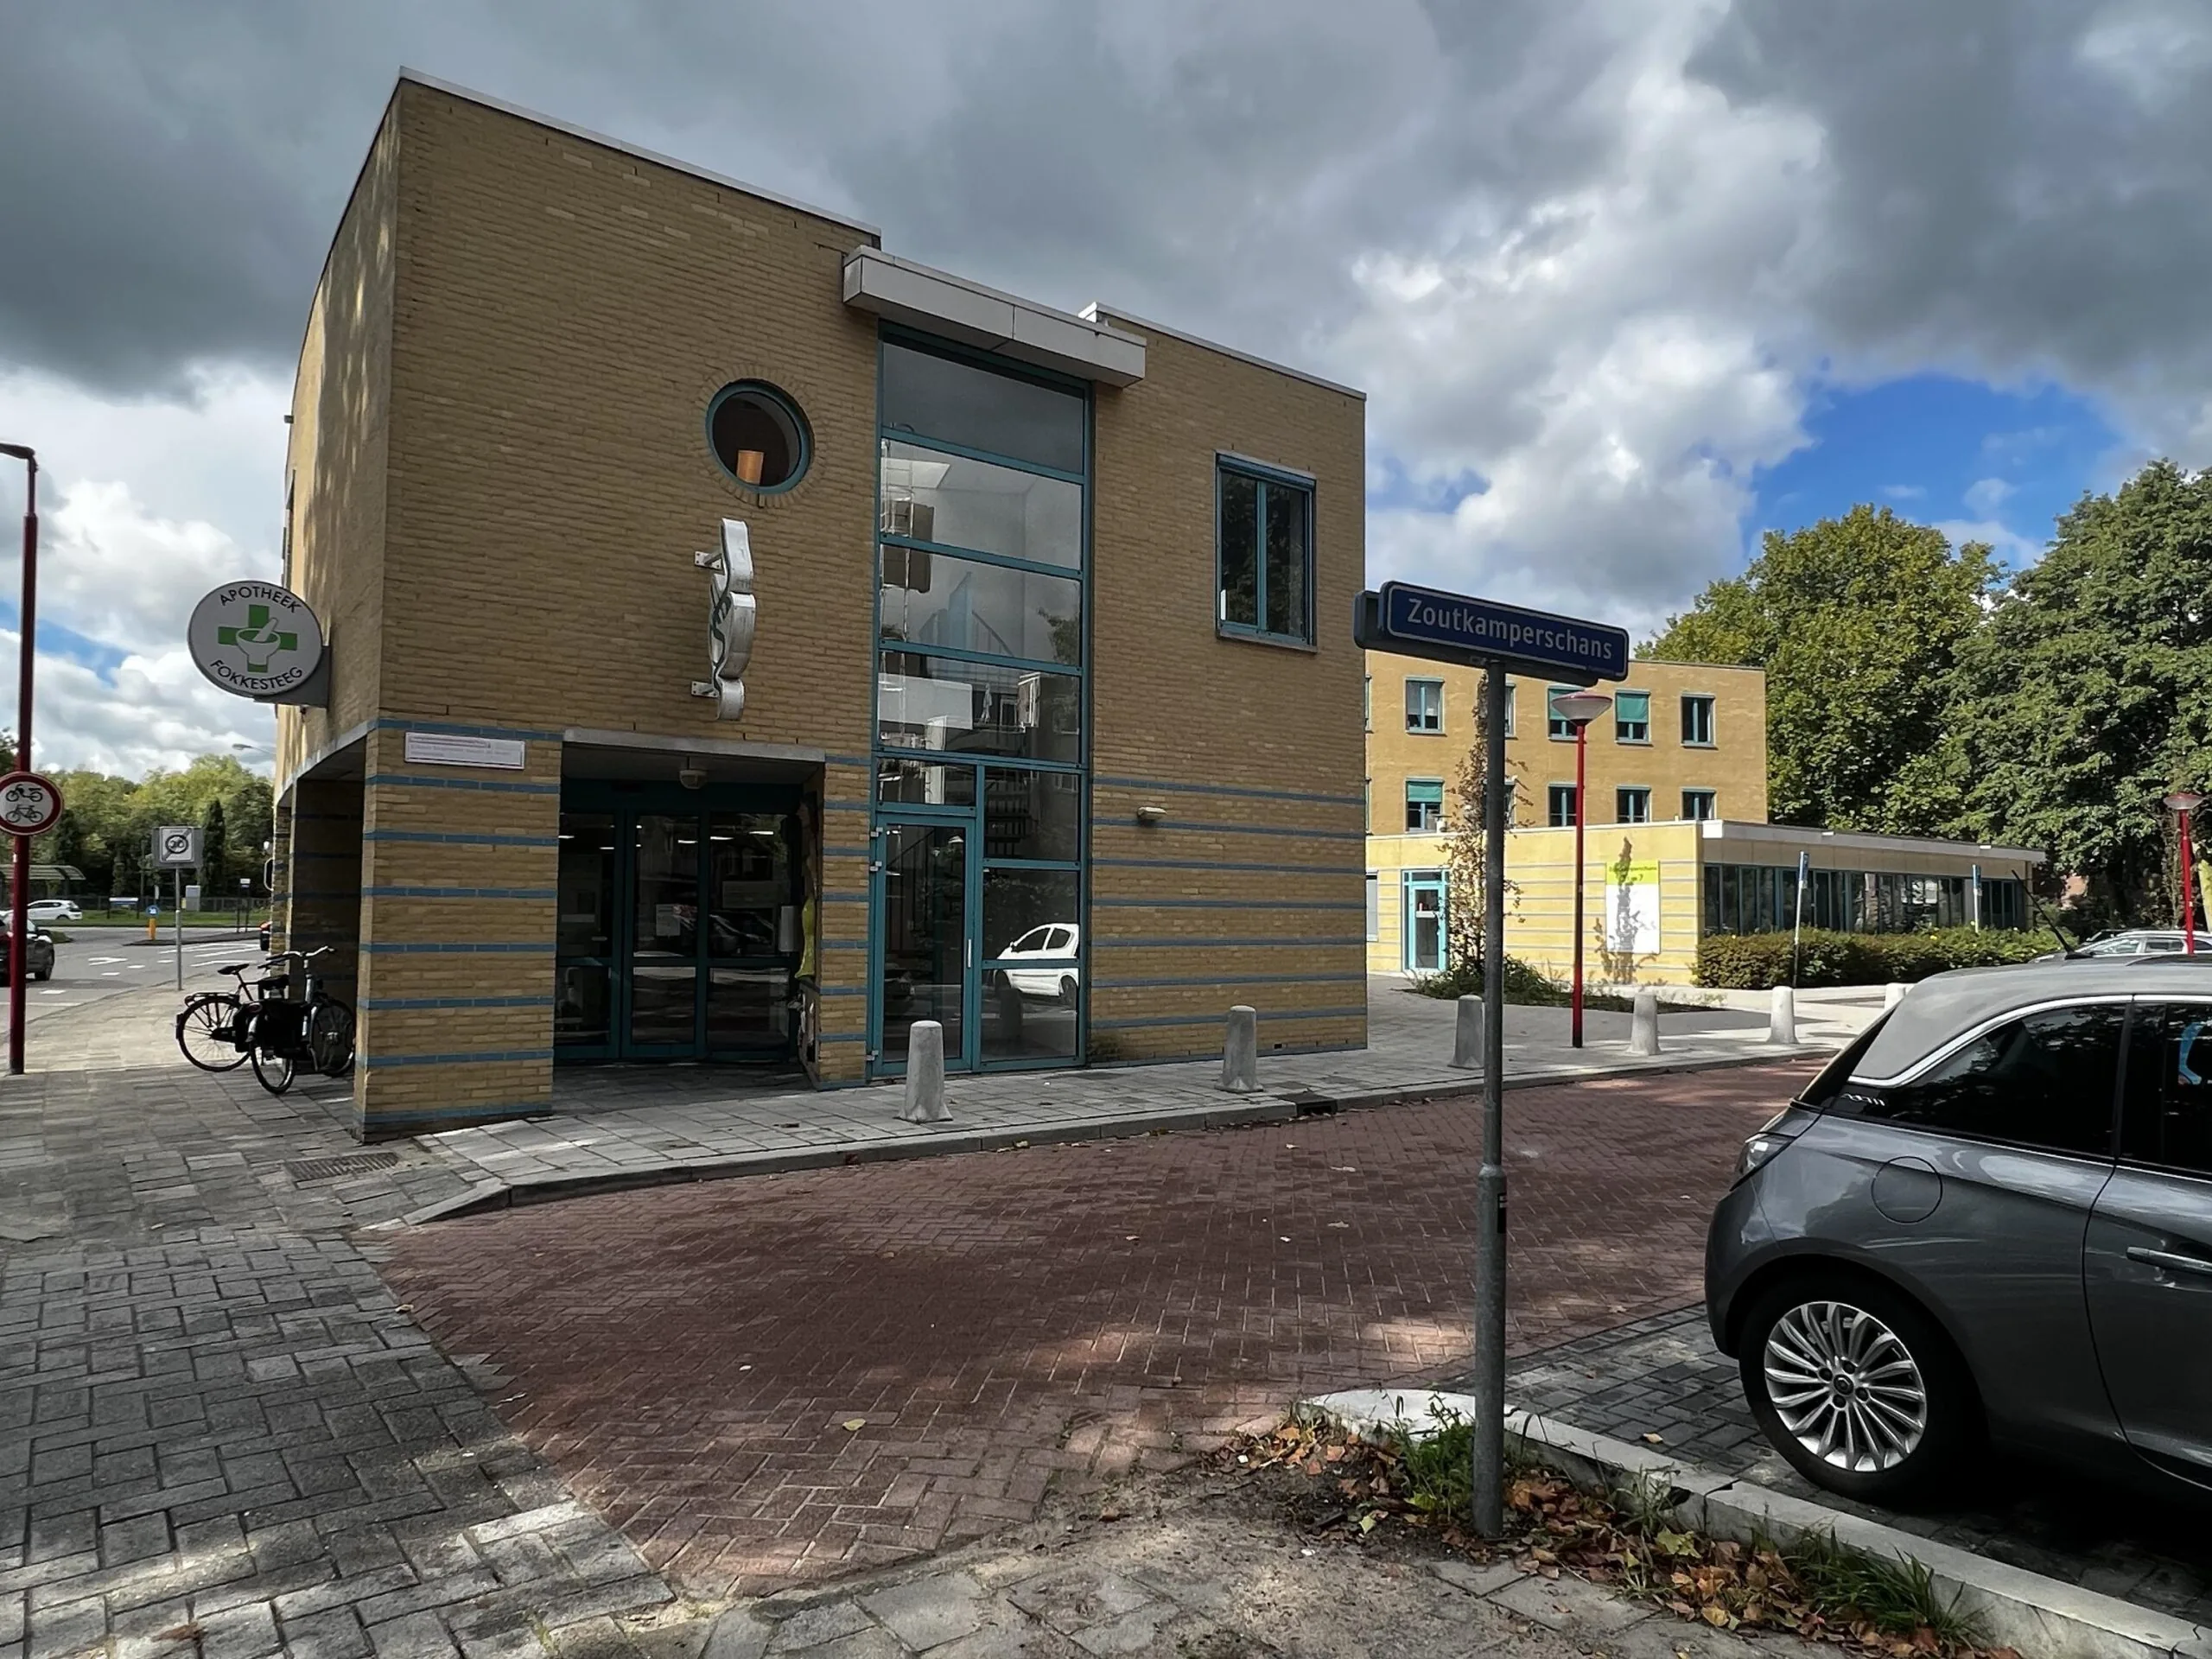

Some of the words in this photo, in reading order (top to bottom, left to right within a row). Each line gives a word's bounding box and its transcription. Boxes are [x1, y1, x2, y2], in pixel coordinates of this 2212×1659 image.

[219, 587, 302, 613] APOTHEEK
[1407, 598, 1612, 660] Zoutkamperschans
[210, 659, 302, 690] FOKKESTEEG
